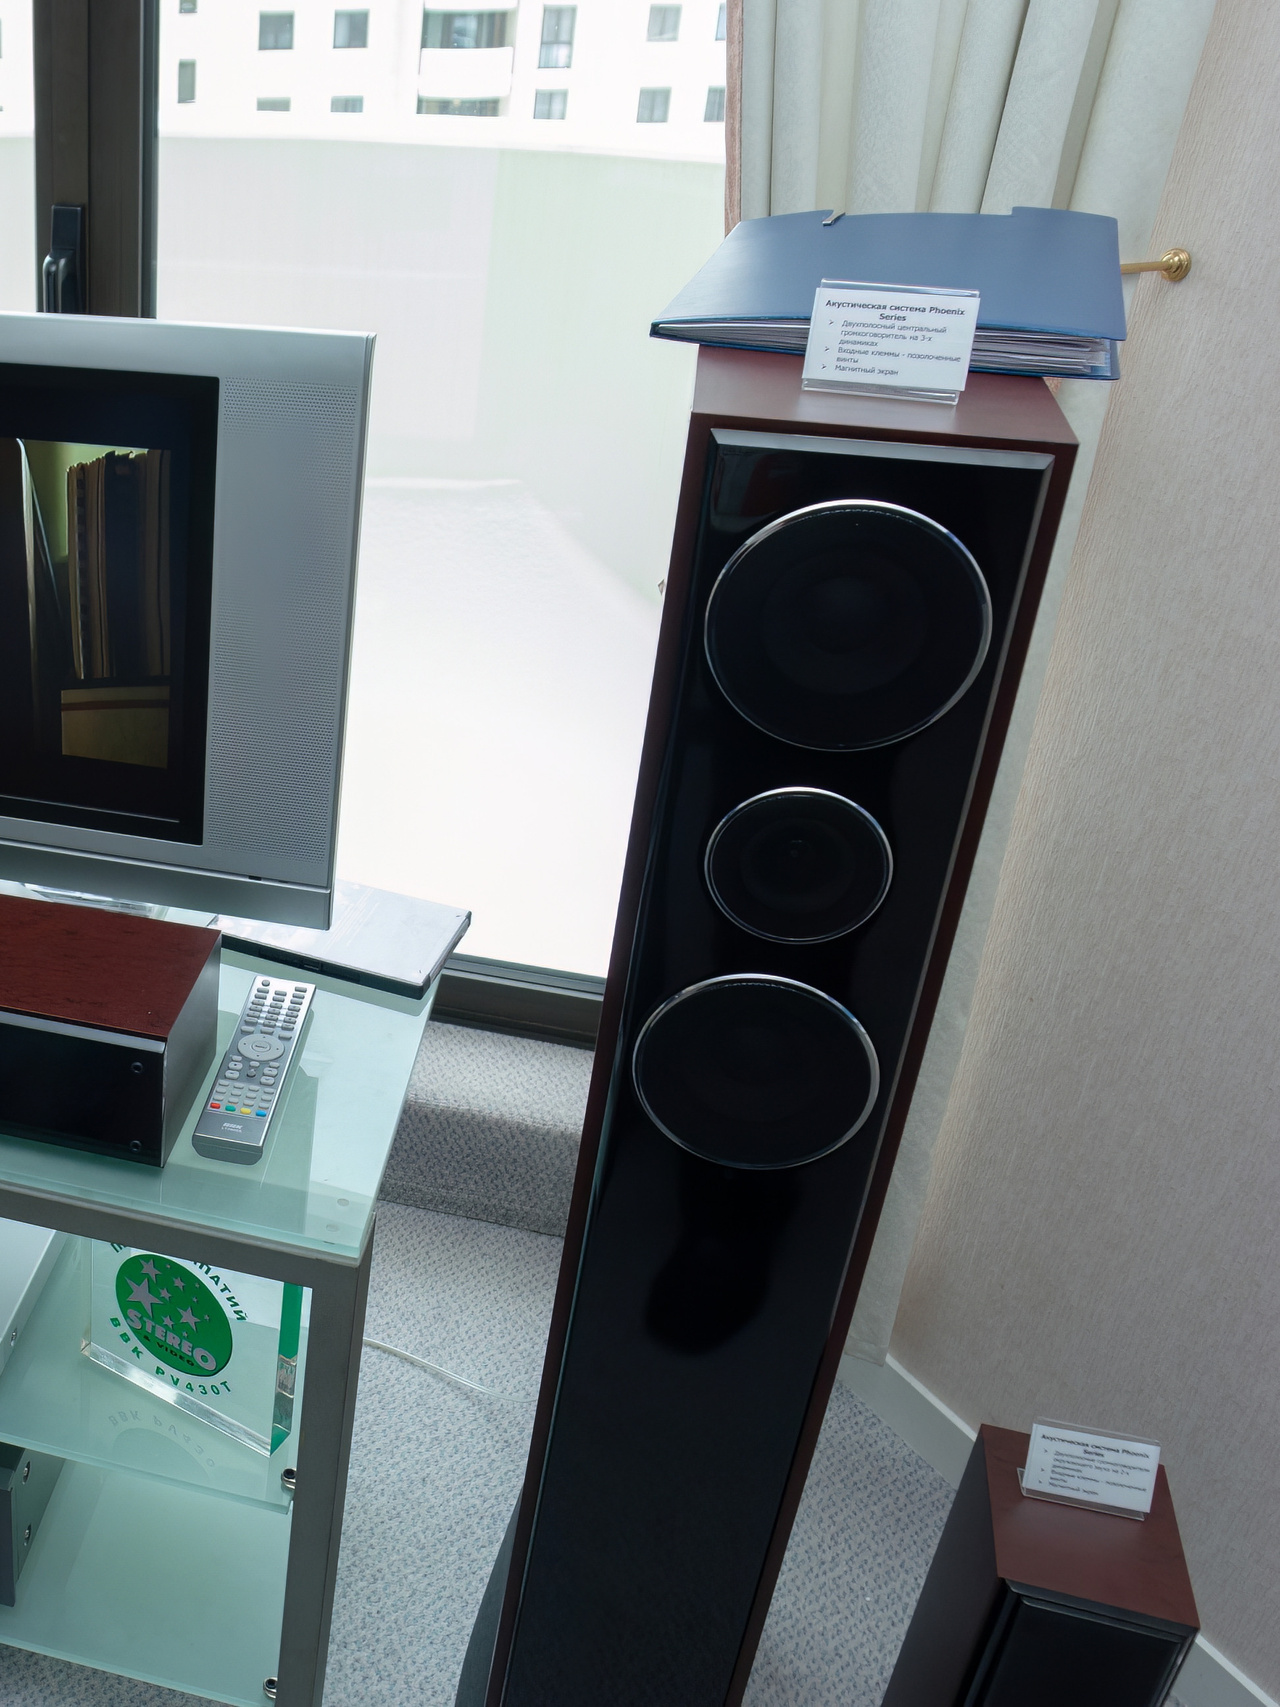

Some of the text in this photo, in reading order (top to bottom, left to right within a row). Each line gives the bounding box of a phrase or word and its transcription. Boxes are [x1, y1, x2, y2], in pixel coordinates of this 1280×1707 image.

[825, 299, 966, 316] Акустическая система Phoenix
[879, 312, 907, 322] Series
[841, 319, 947, 334] Двухполосный центральный
[838, 339, 878, 347] динамиках
[840, 329, 907, 341] громкоговоритель
[920, 334, 933, 342] 3-х
[837, 347, 869, 356] Входные
[871, 350, 900, 358] клеммы
[907, 352, 961, 363] позолоченные
[834, 364, 876, 375] Магнитный
[126, 1308, 217, 1371] STEREO
[109, 1317, 231, 1395] BBK PV430T
[156, 1340, 195, 1367] VIDEO
